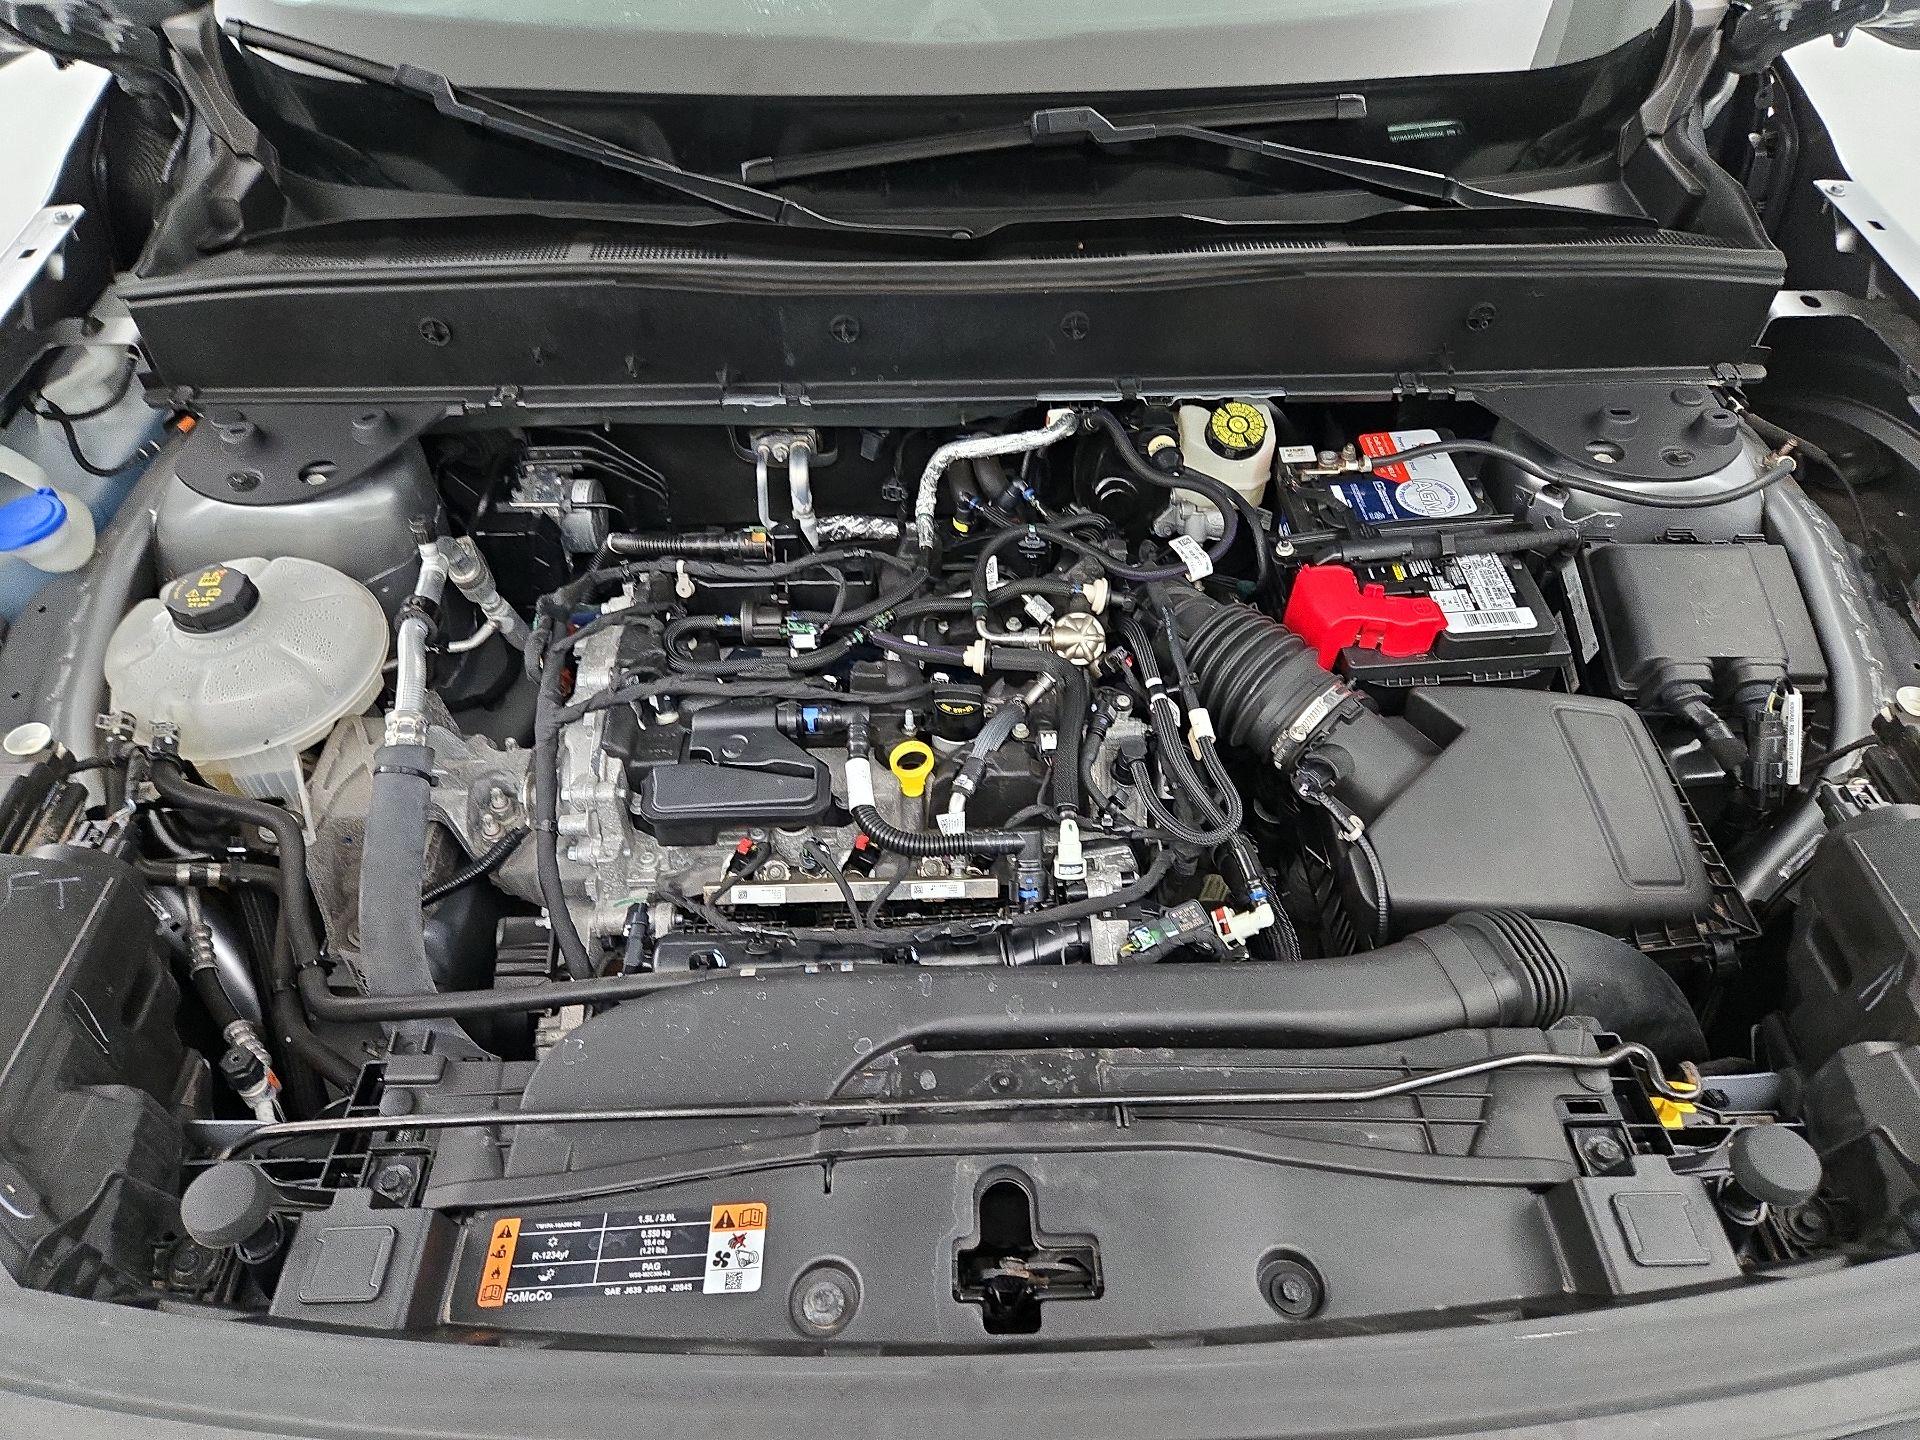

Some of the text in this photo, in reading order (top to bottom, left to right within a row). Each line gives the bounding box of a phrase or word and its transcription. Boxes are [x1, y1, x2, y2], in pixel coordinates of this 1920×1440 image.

[1412, 480, 1447, 516] AGM
[661, 1229, 671, 1239] kg
[531, 1249, 570, 1261] R-1234yf
[642, 1261, 661, 1271] PAG
[504, 1289, 553, 1304] FoMoCo
[604, 1286, 621, 1296] SAE
